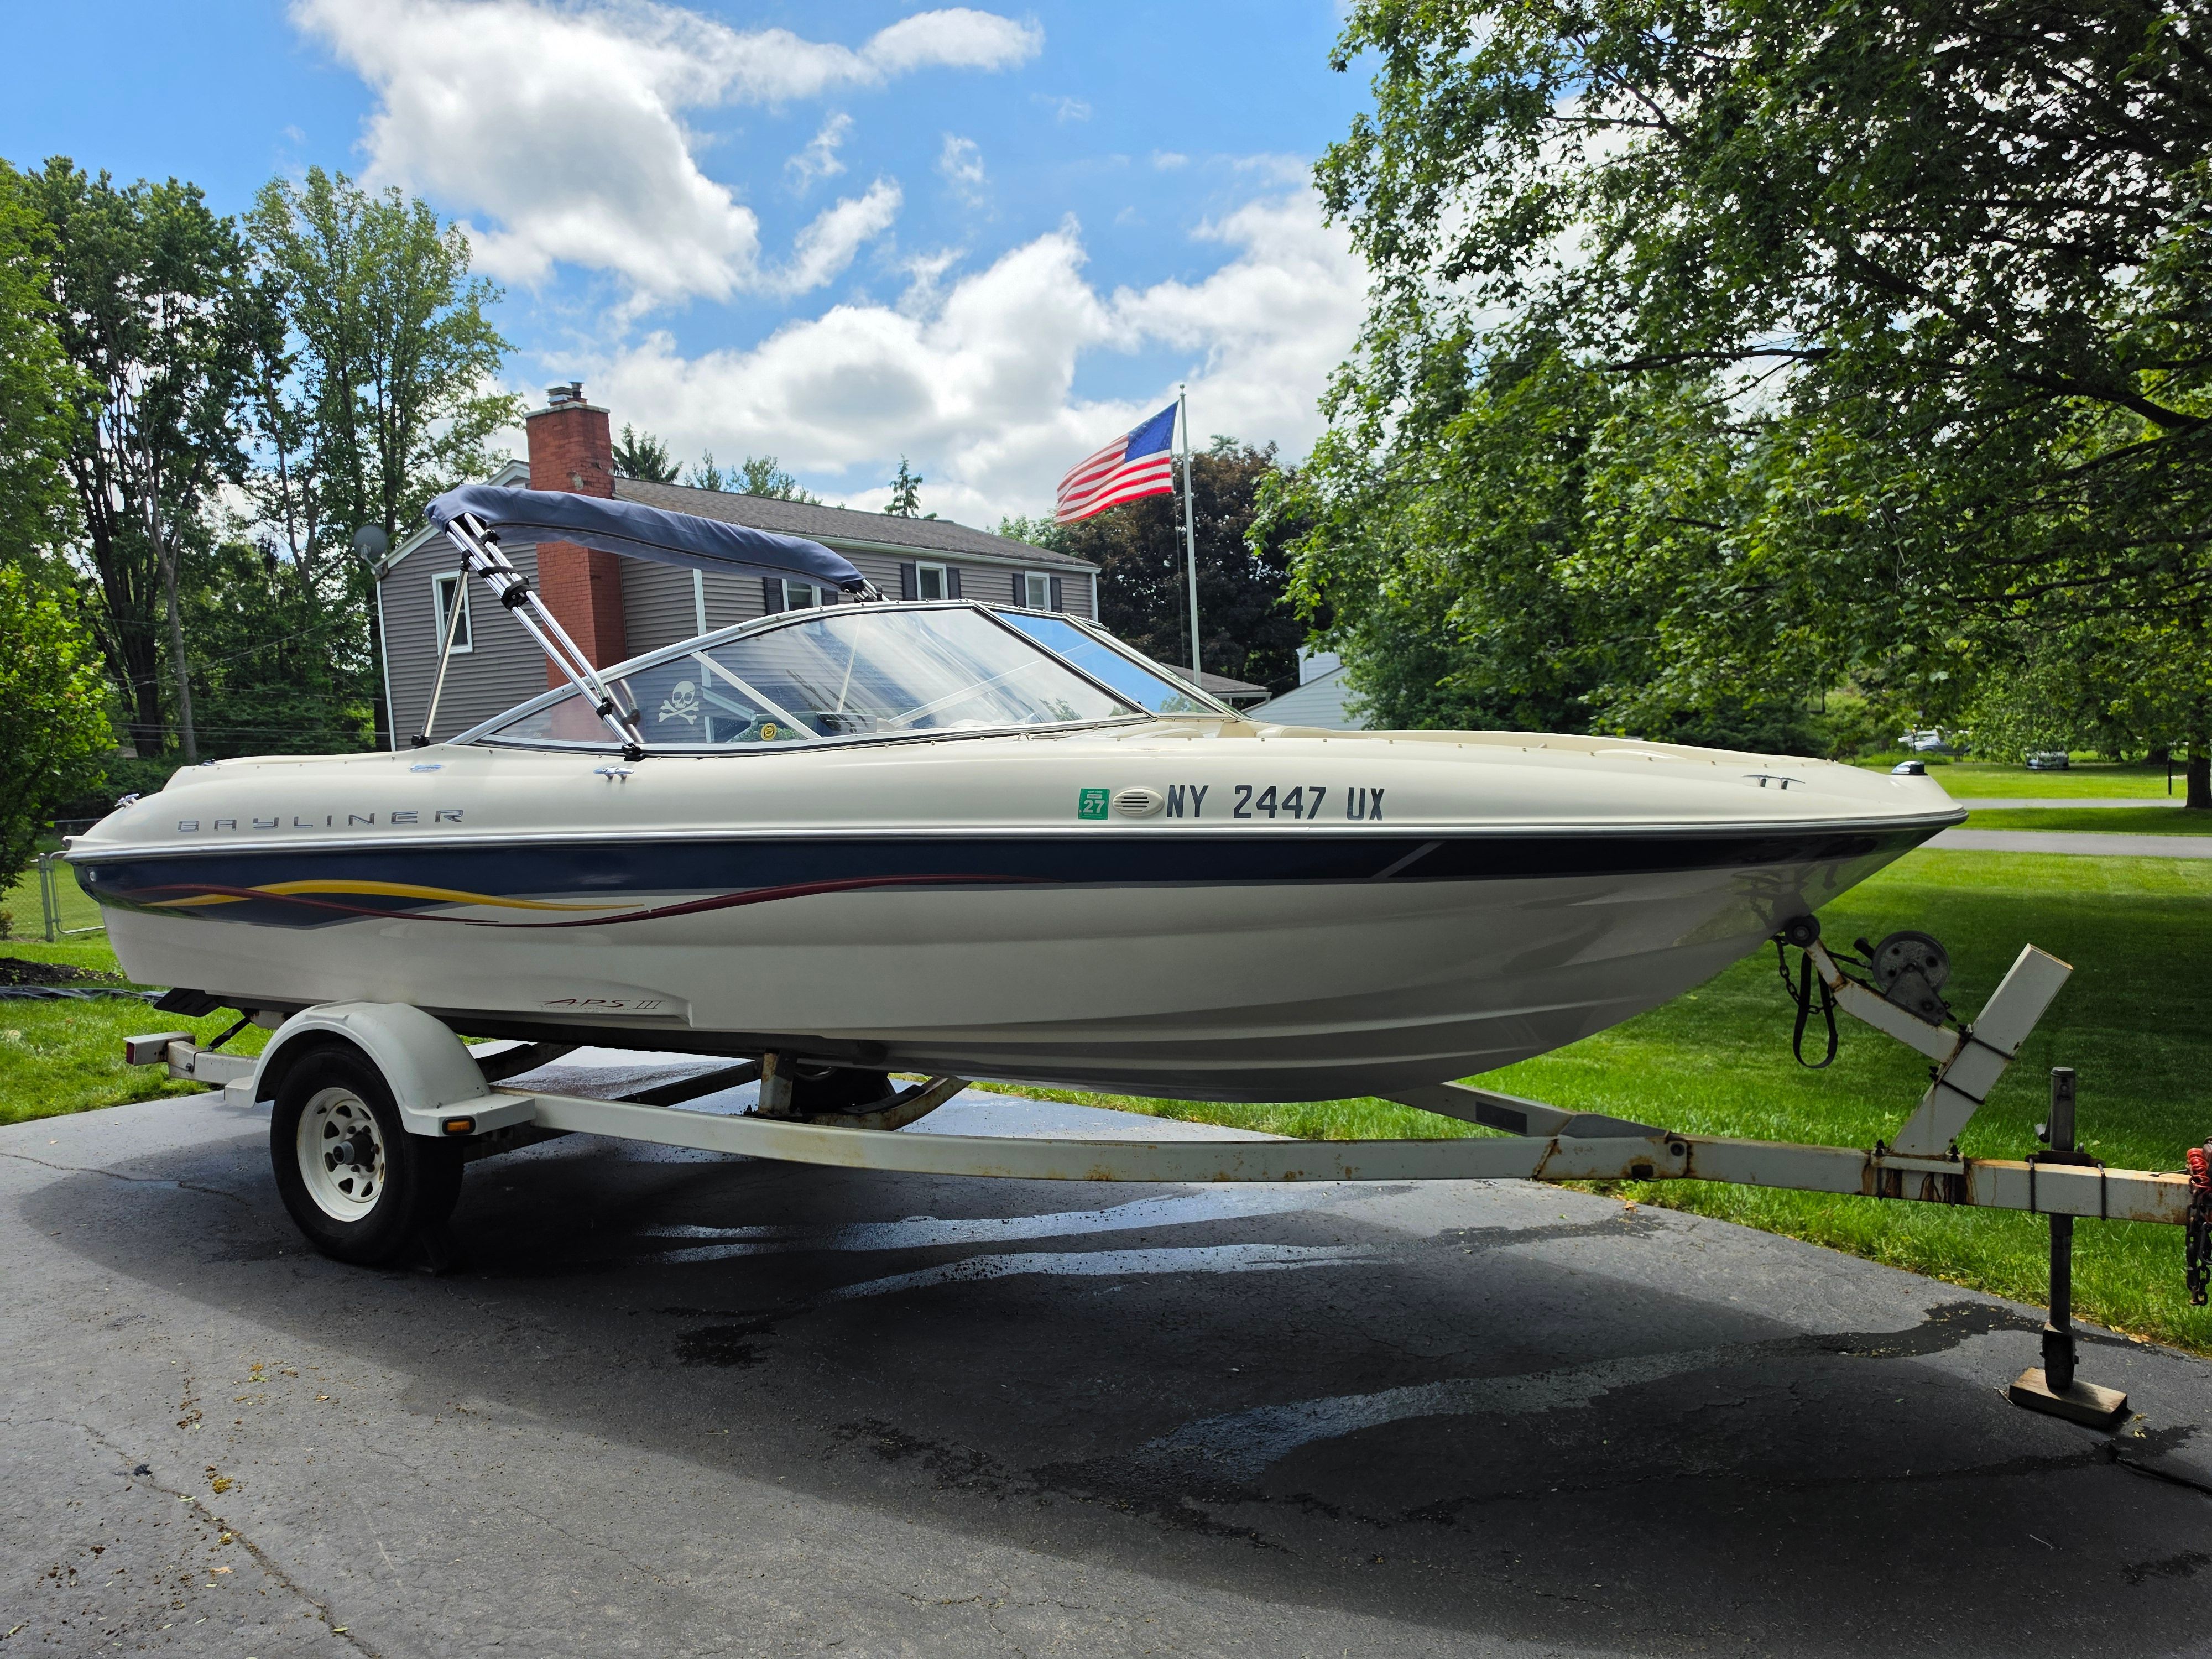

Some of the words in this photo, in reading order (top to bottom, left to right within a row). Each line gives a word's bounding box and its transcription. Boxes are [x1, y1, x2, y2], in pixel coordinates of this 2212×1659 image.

[1083, 800, 1105, 813] 27
[1167, 785, 1209, 818] NY
[1234, 785, 1327, 820] 2447
[1347, 787, 1385, 821] UX
[178, 809, 463, 832] BAYLINER
[539, 999, 631, 1008] APS
[633, 1000, 665, 1009] III
